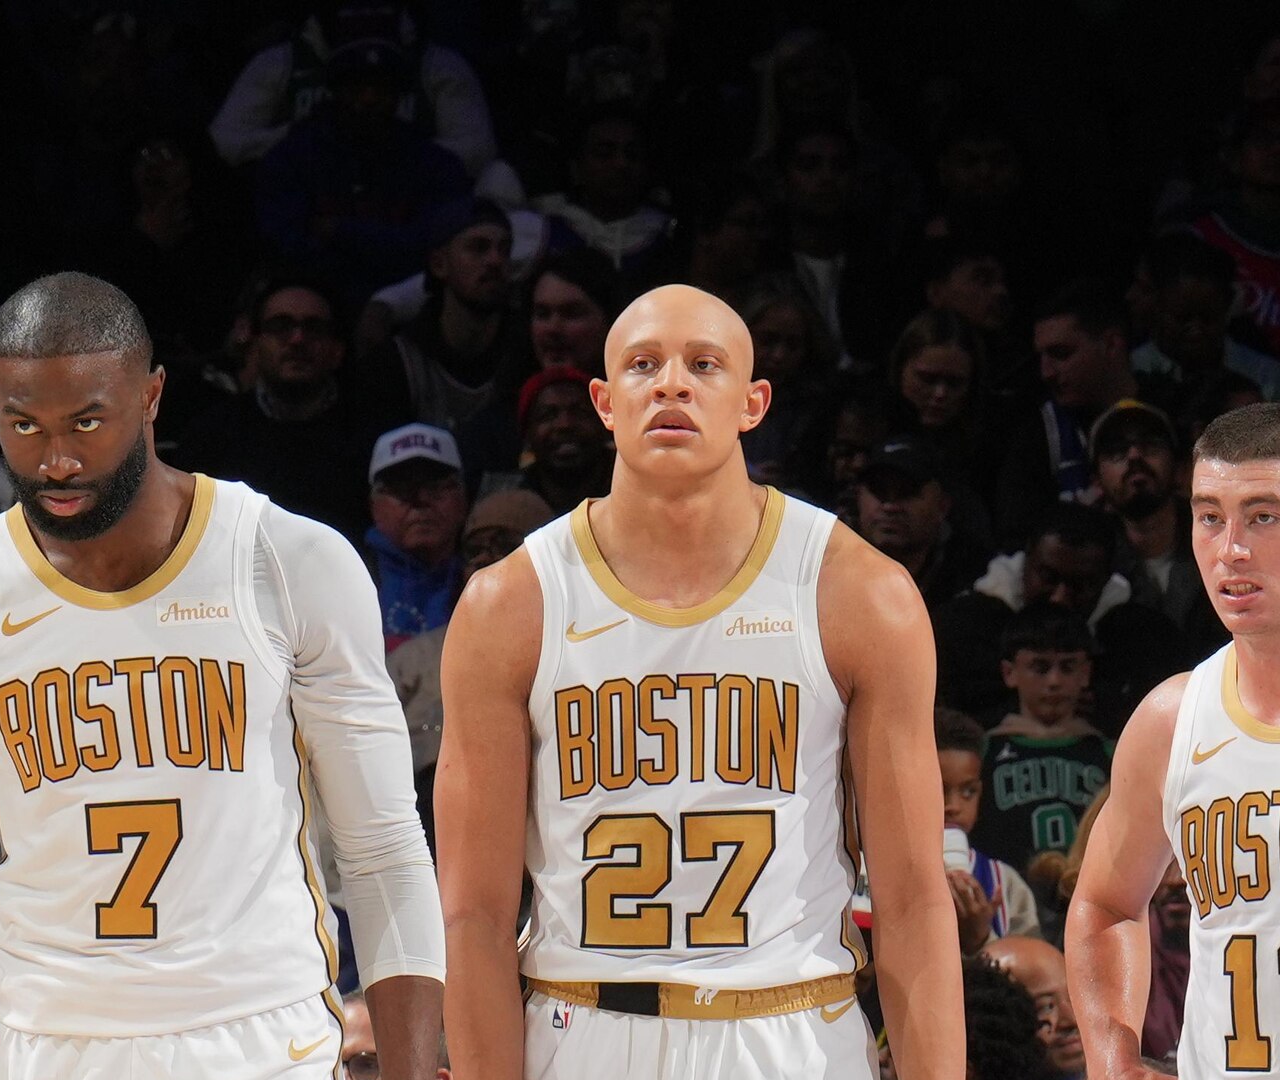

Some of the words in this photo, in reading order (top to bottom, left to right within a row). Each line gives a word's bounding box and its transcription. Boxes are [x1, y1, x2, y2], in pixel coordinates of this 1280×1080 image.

[389, 433, 441, 456] PHILA
[160, 601, 230, 624] Amica
[726, 615, 794, 637] Amica
[554, 673, 800, 802] BOSTON
[992, 756, 1107, 812] CELTICS
[84, 798, 184, 940] 7
[580, 809, 777, 949] 27
